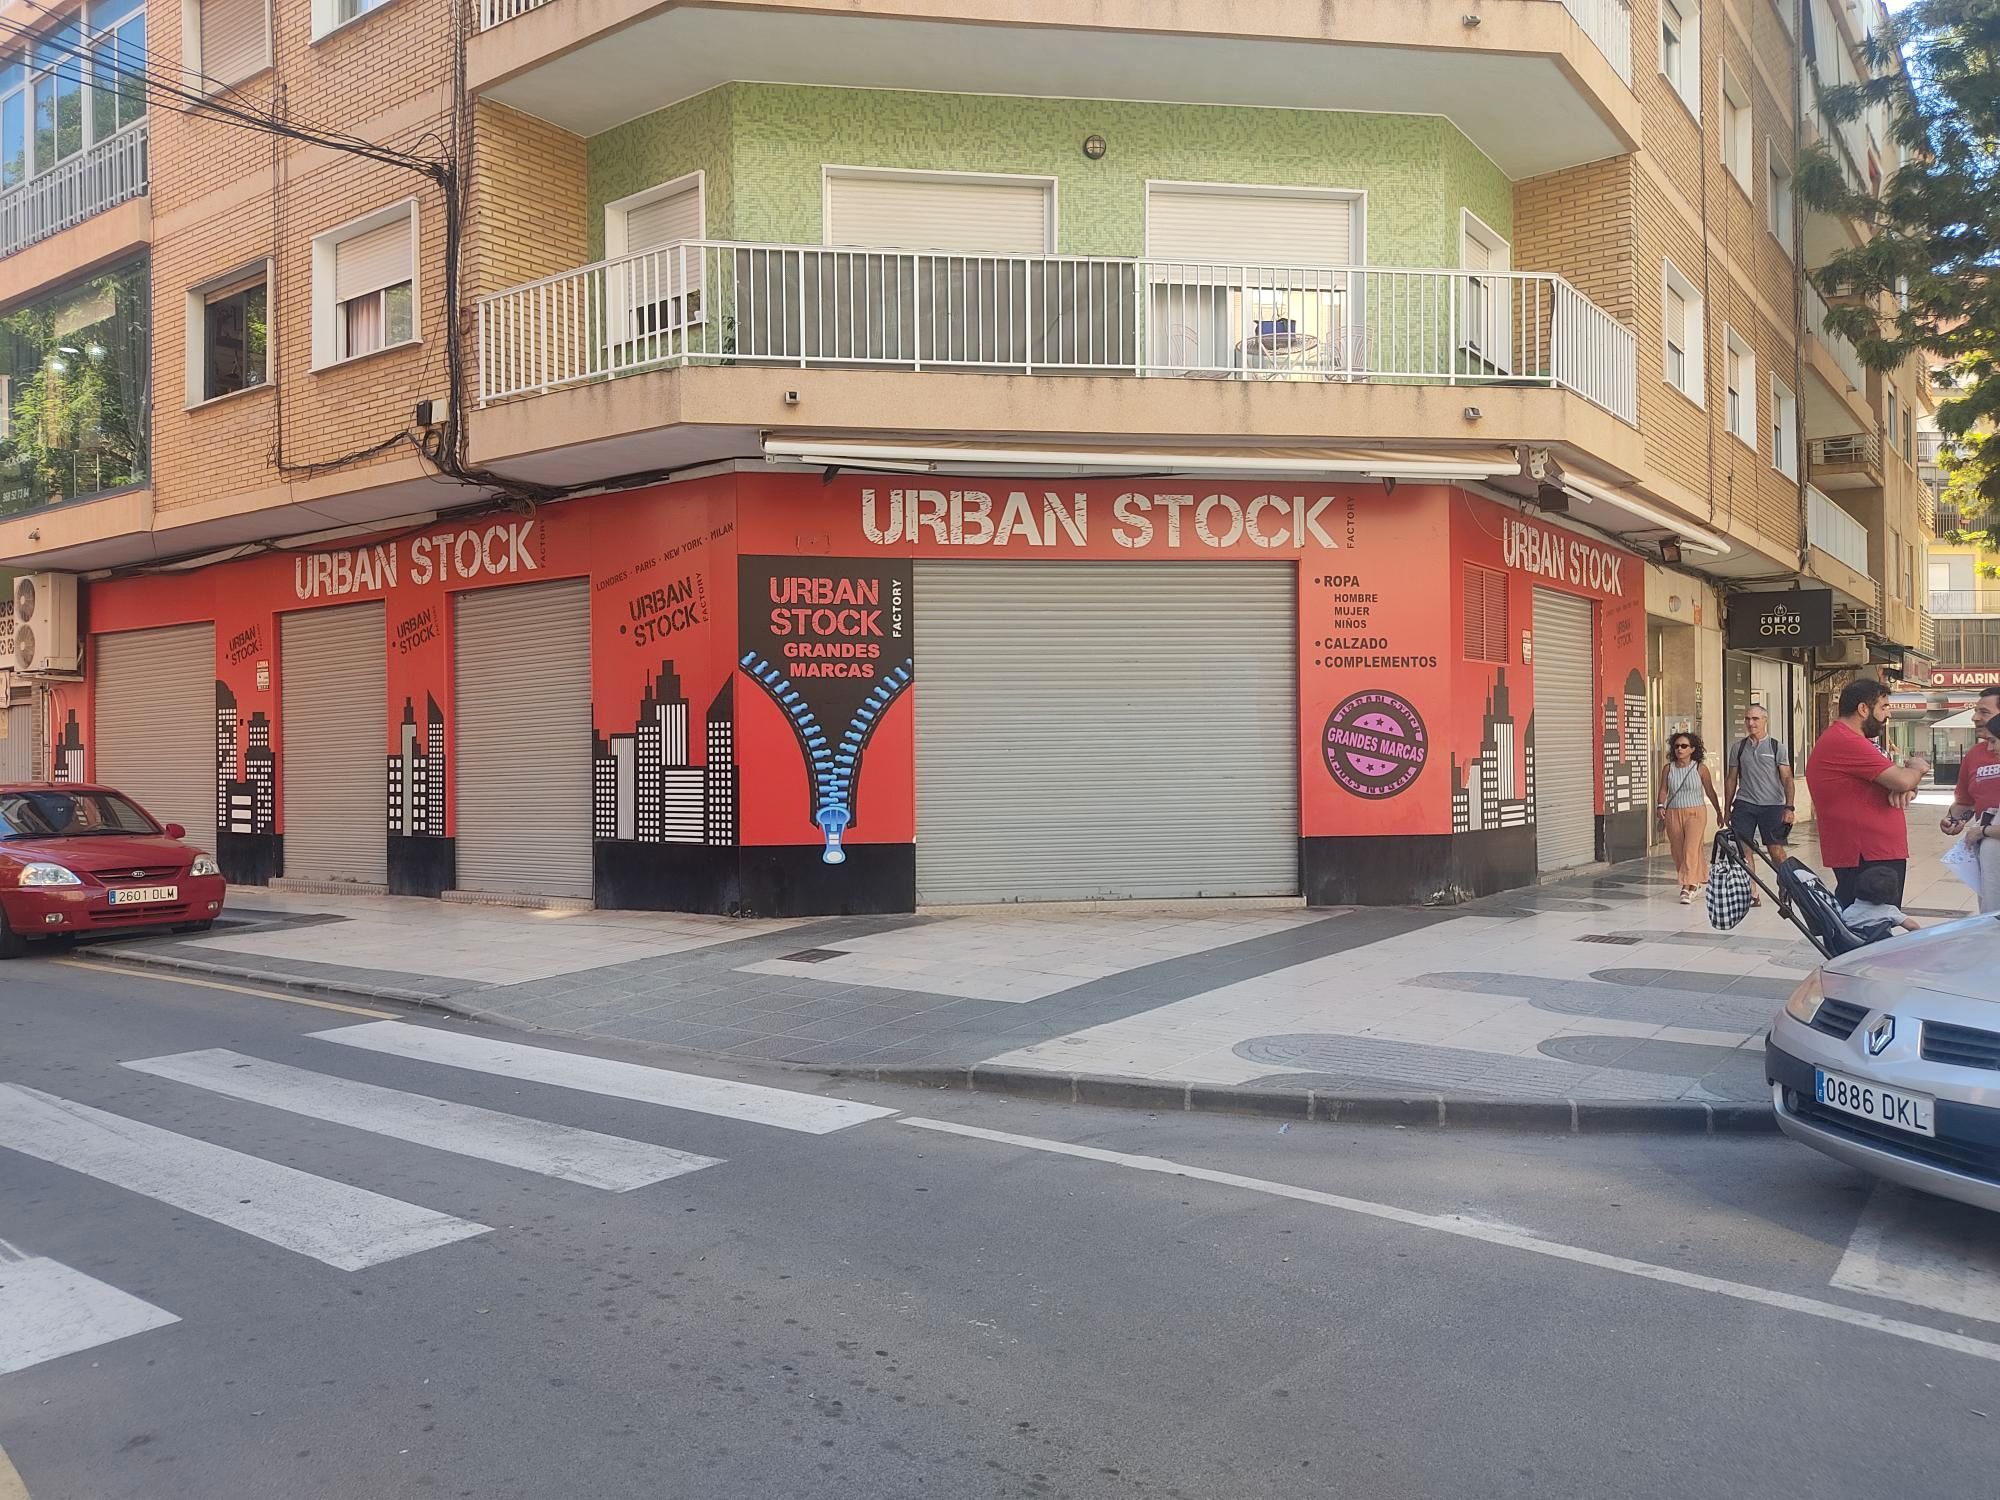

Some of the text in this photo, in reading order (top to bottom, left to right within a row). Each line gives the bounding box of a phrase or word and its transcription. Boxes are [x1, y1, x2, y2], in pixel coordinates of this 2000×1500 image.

[862, 488, 1338, 549] URBAN STOCK
[1346, 496, 1355, 549] FACTORY
[295, 520, 537, 600] URBAN STOCK
[596, 522, 734, 592] LONDRES PARIS NEW YORK MILAN
[1503, 517, 1623, 597] URBAN STOCK
[770, 576, 879, 605] URBAN
[1323, 575, 1360, 587] ROPA
[629, 576, 693, 621] URBAN
[696, 573, 709, 622] FACTORY
[892, 579, 902, 638] FACTORY
[1334, 594, 1378, 603] HOMBRE
[1334, 607, 1370, 616] MUJER
[397, 608, 431, 638] URBAN
[634, 602, 700, 647] STOCK
[770, 608, 885, 637] STOCK
[1334, 618, 1367, 629] NIÑOS
[1760, 615, 1800, 624] COMPRO
[1760, 623, 1800, 635] ORO
[229, 625, 256, 652] URBAN
[231, 640, 259, 666] STOCK
[400, 624, 436, 655] STOCK
[783, 643, 881, 659] GRANDES
[1324, 638, 1388, 649] CALZADO
[790, 663, 875, 678] MARCAS
[1324, 656, 1437, 668] COMPLEMENTOS
[1952, 673, 1999, 685] MARIN
[1327, 727, 1425, 763] GRANDES MARCAS
[119, 888, 174, 902] 2601 DLM
[1826, 1077, 1928, 1131] 0886 DKL
